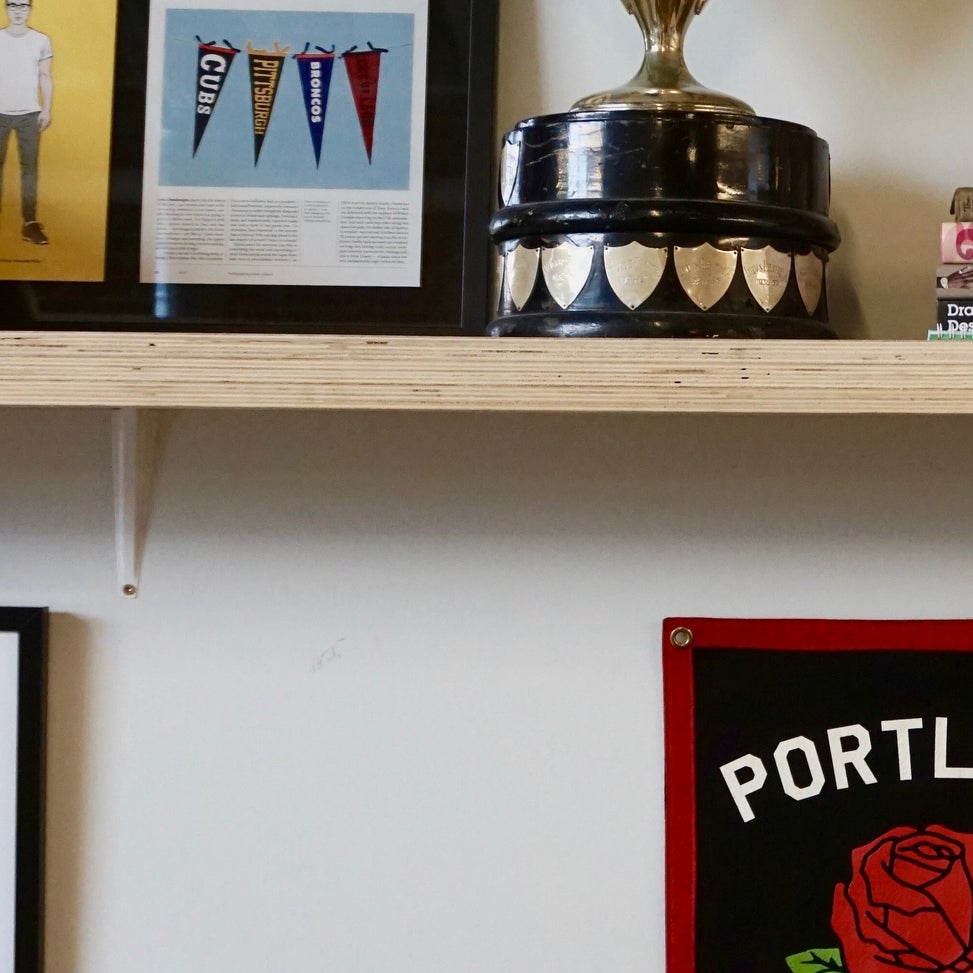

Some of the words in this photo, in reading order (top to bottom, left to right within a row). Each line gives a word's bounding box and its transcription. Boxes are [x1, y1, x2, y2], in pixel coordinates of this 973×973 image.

[197, 53, 226, 115] CUBS
[253, 59, 279, 135] PITTSBURGH
[310, 61, 321, 123] BRONCOS
